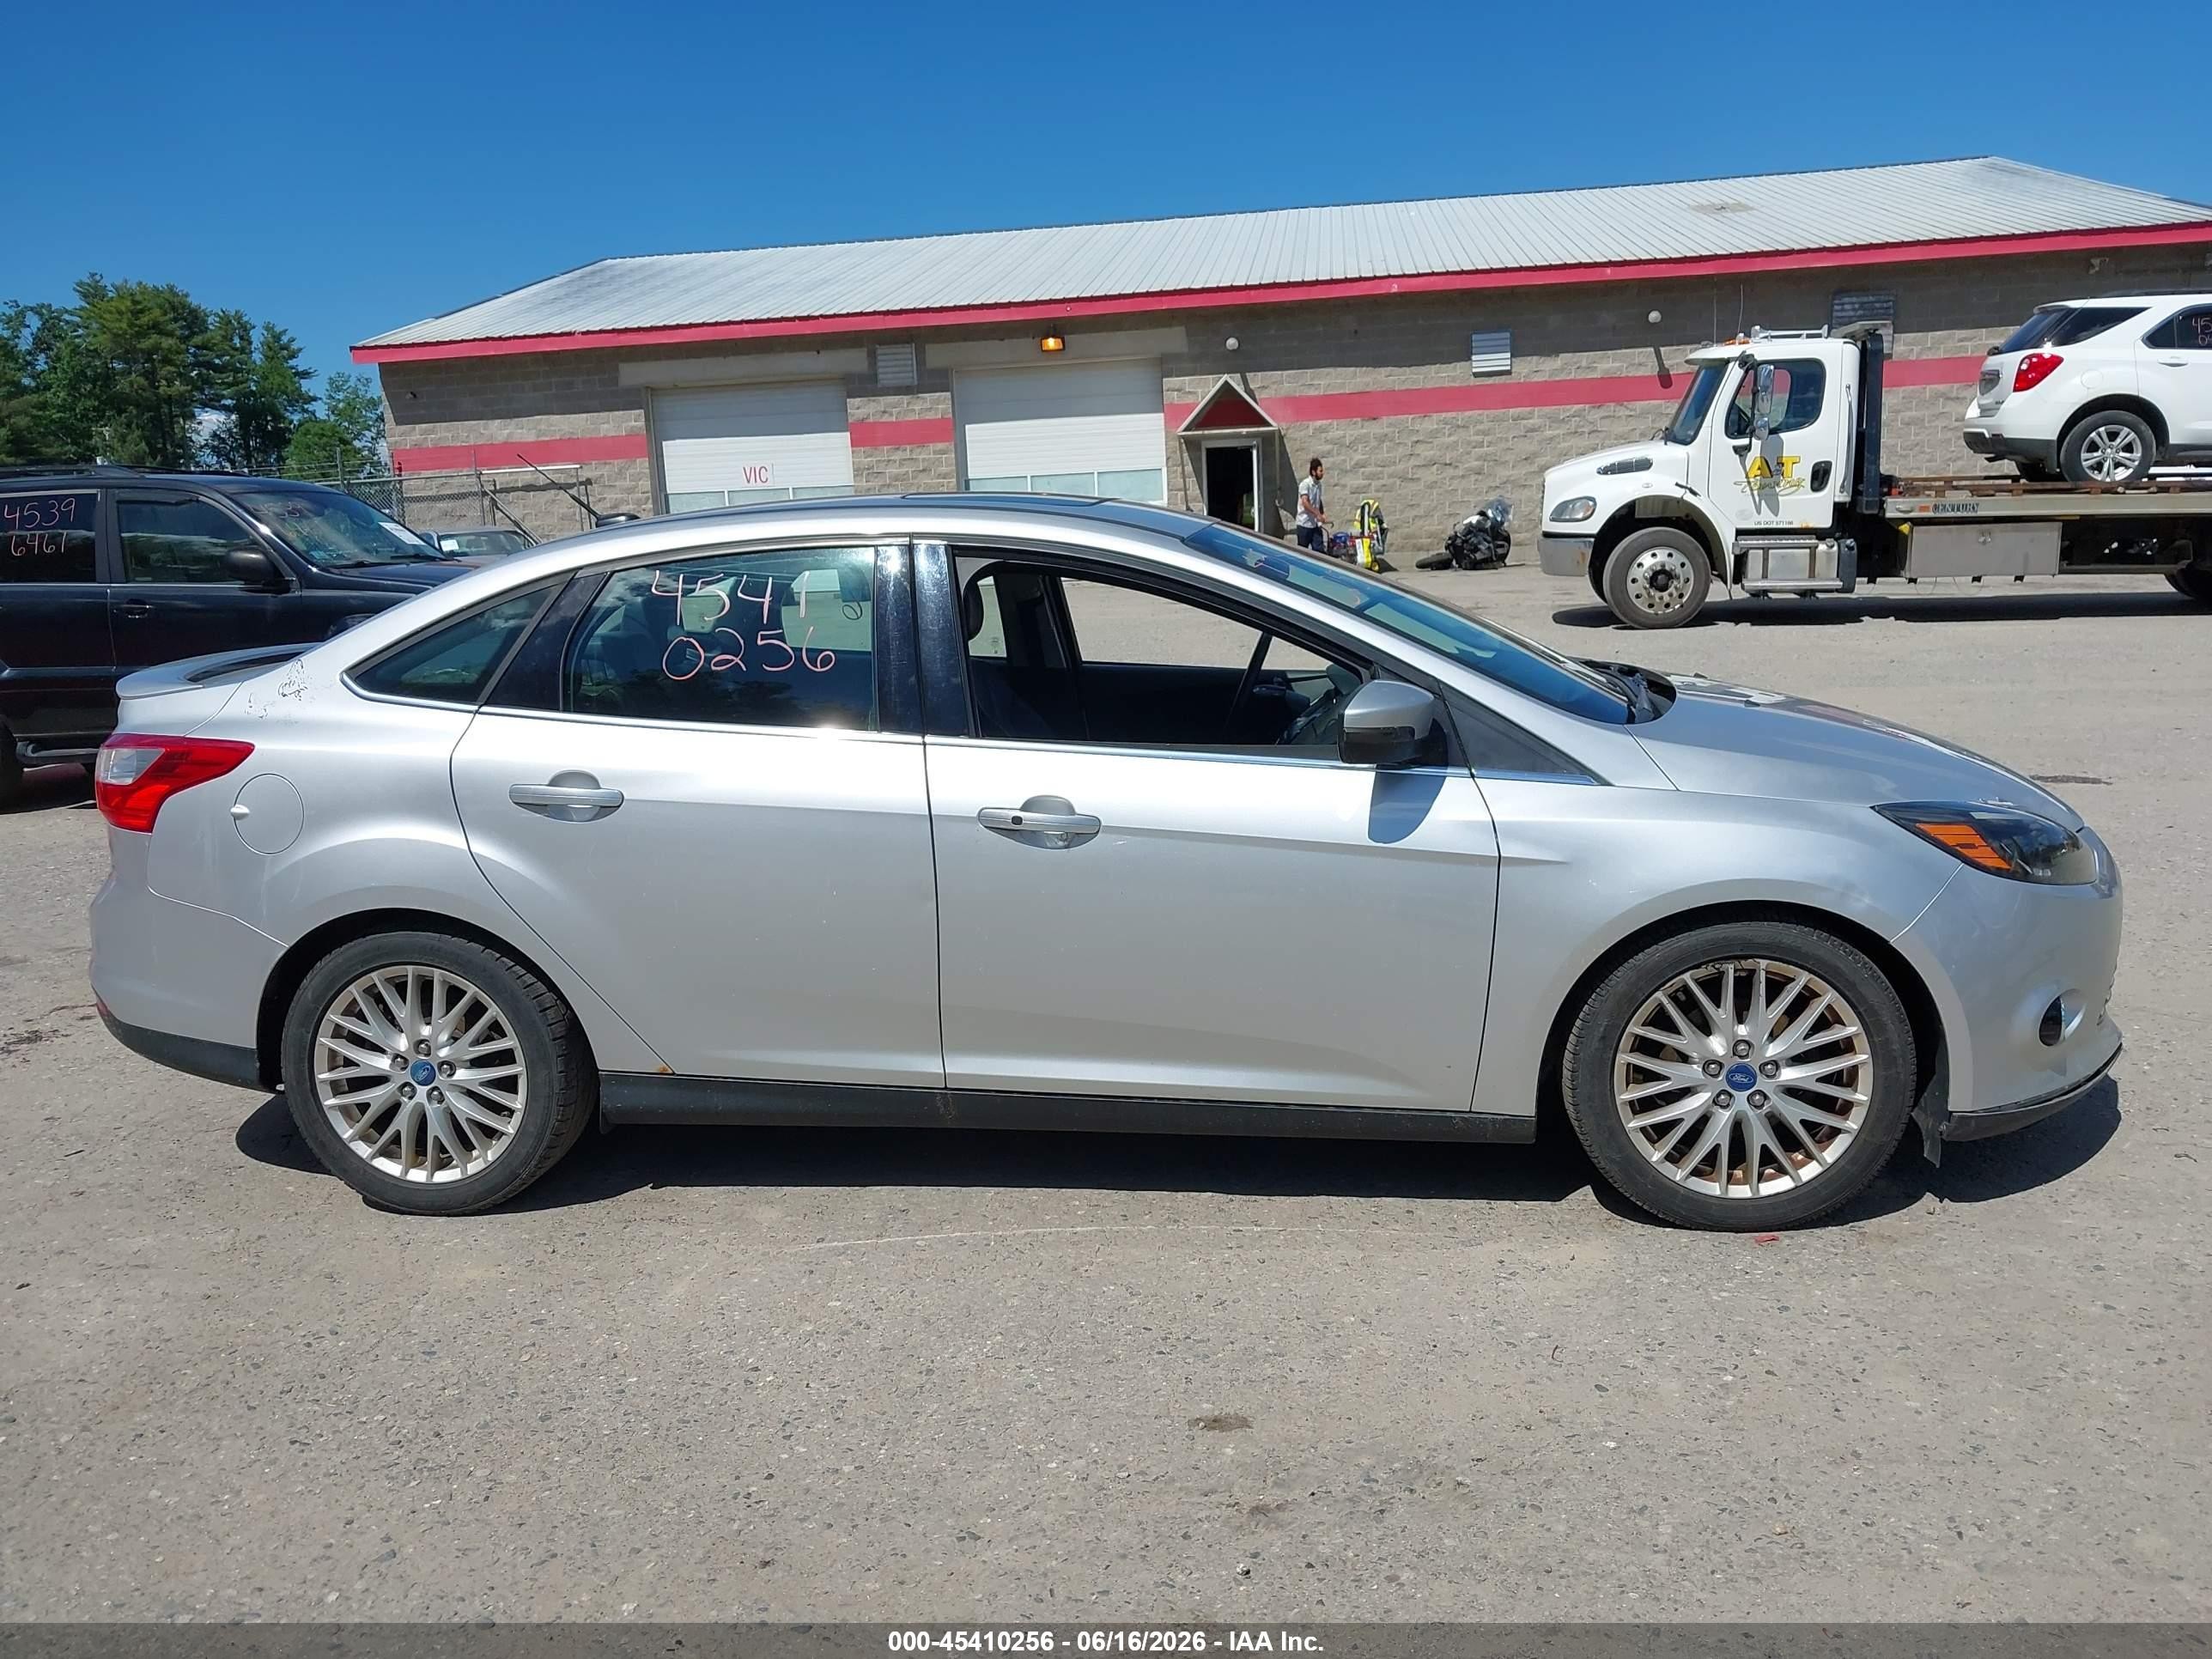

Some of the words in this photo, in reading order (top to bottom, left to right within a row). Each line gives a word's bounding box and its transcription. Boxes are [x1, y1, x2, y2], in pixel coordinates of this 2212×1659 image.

[743, 465, 769, 483] VIC
[4, 498, 76, 529] 4539
[11, 532, 67, 556] 6461
[652, 569, 809, 626] 4541
[662, 626, 836, 680] 0256
